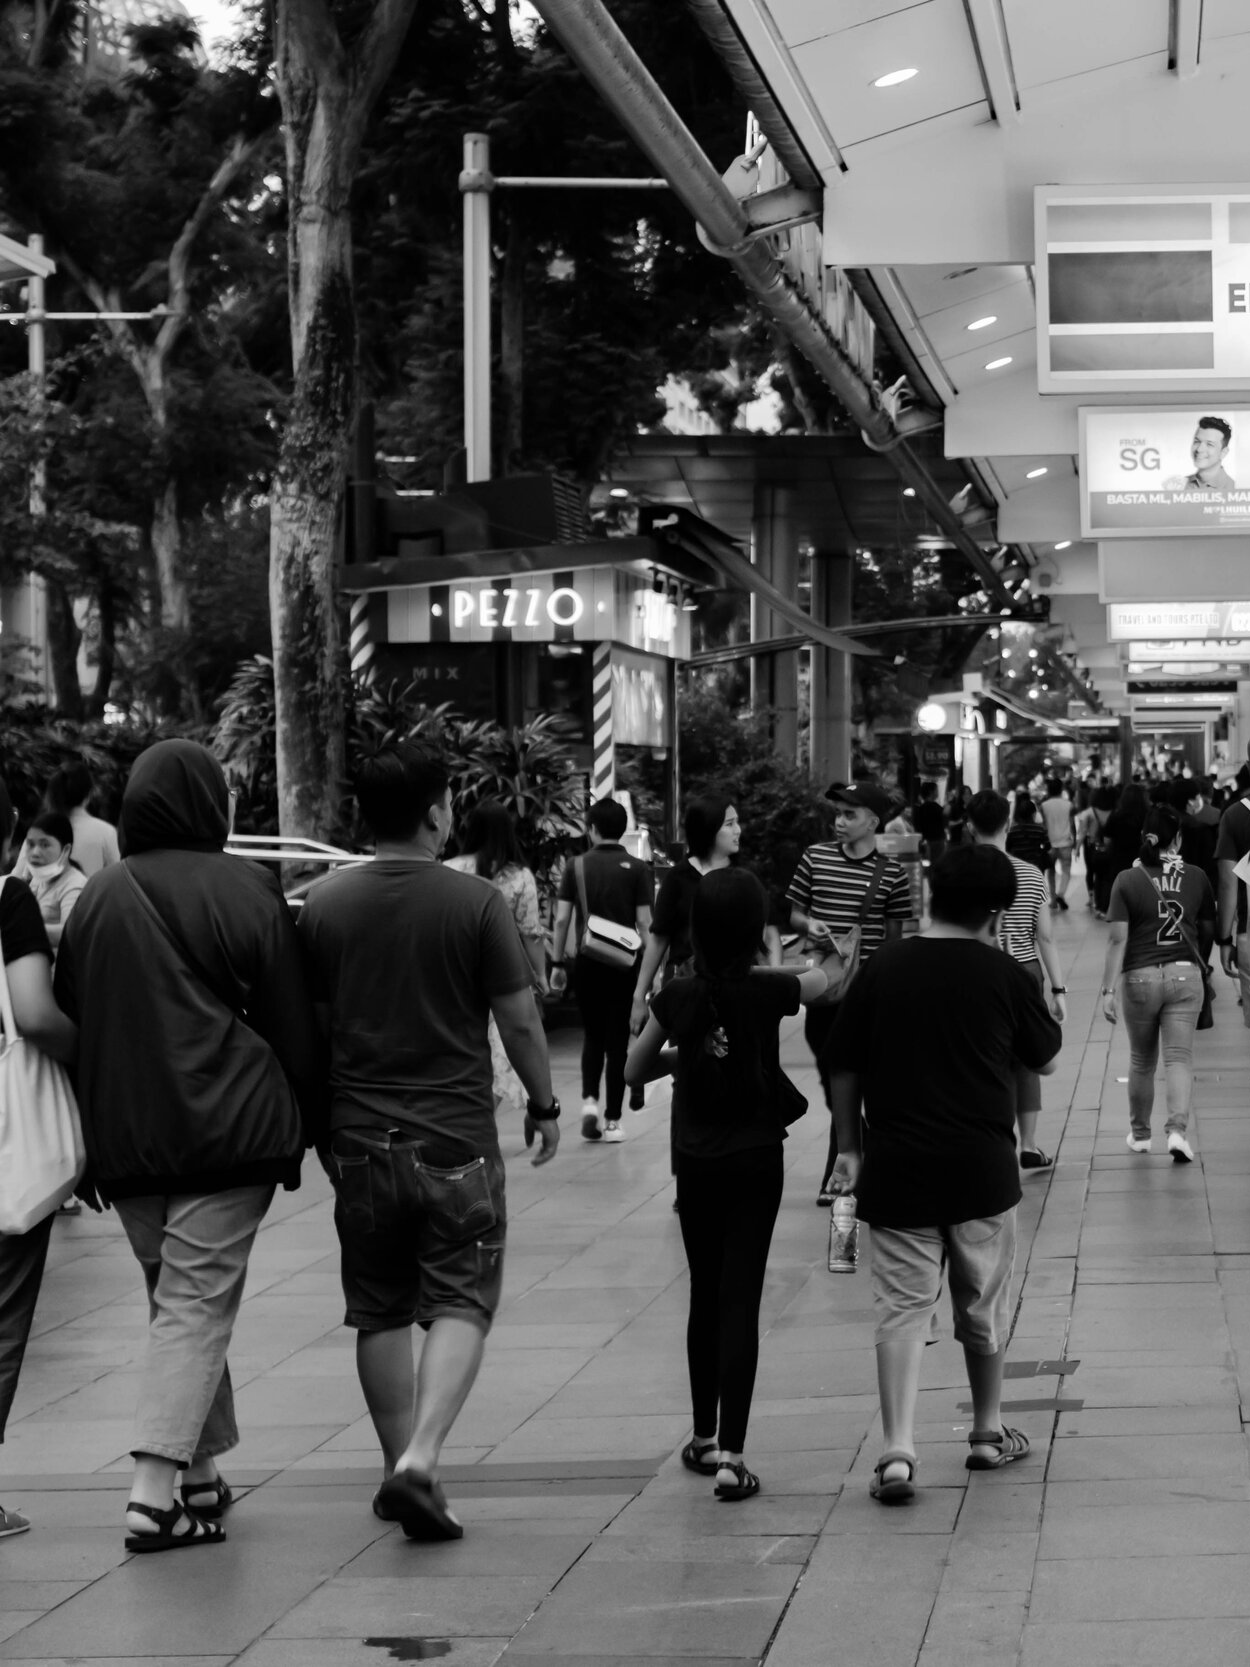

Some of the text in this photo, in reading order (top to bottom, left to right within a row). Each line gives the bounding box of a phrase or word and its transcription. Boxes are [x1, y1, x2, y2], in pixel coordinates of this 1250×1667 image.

[1119, 439, 1146, 447] FROM
[1120, 448, 1161, 471] SG
[1107, 494, 1148, 505] BASTA
[1149, 494, 1171, 505] ML,
[1173, 492, 1226, 504] MABILIS,
[454, 587, 584, 628] PEZZO
[1118, 615, 1144, 625] TRAVEL
[413, 667, 459, 679] MIX
[1156, 899, 1184, 946] 2
